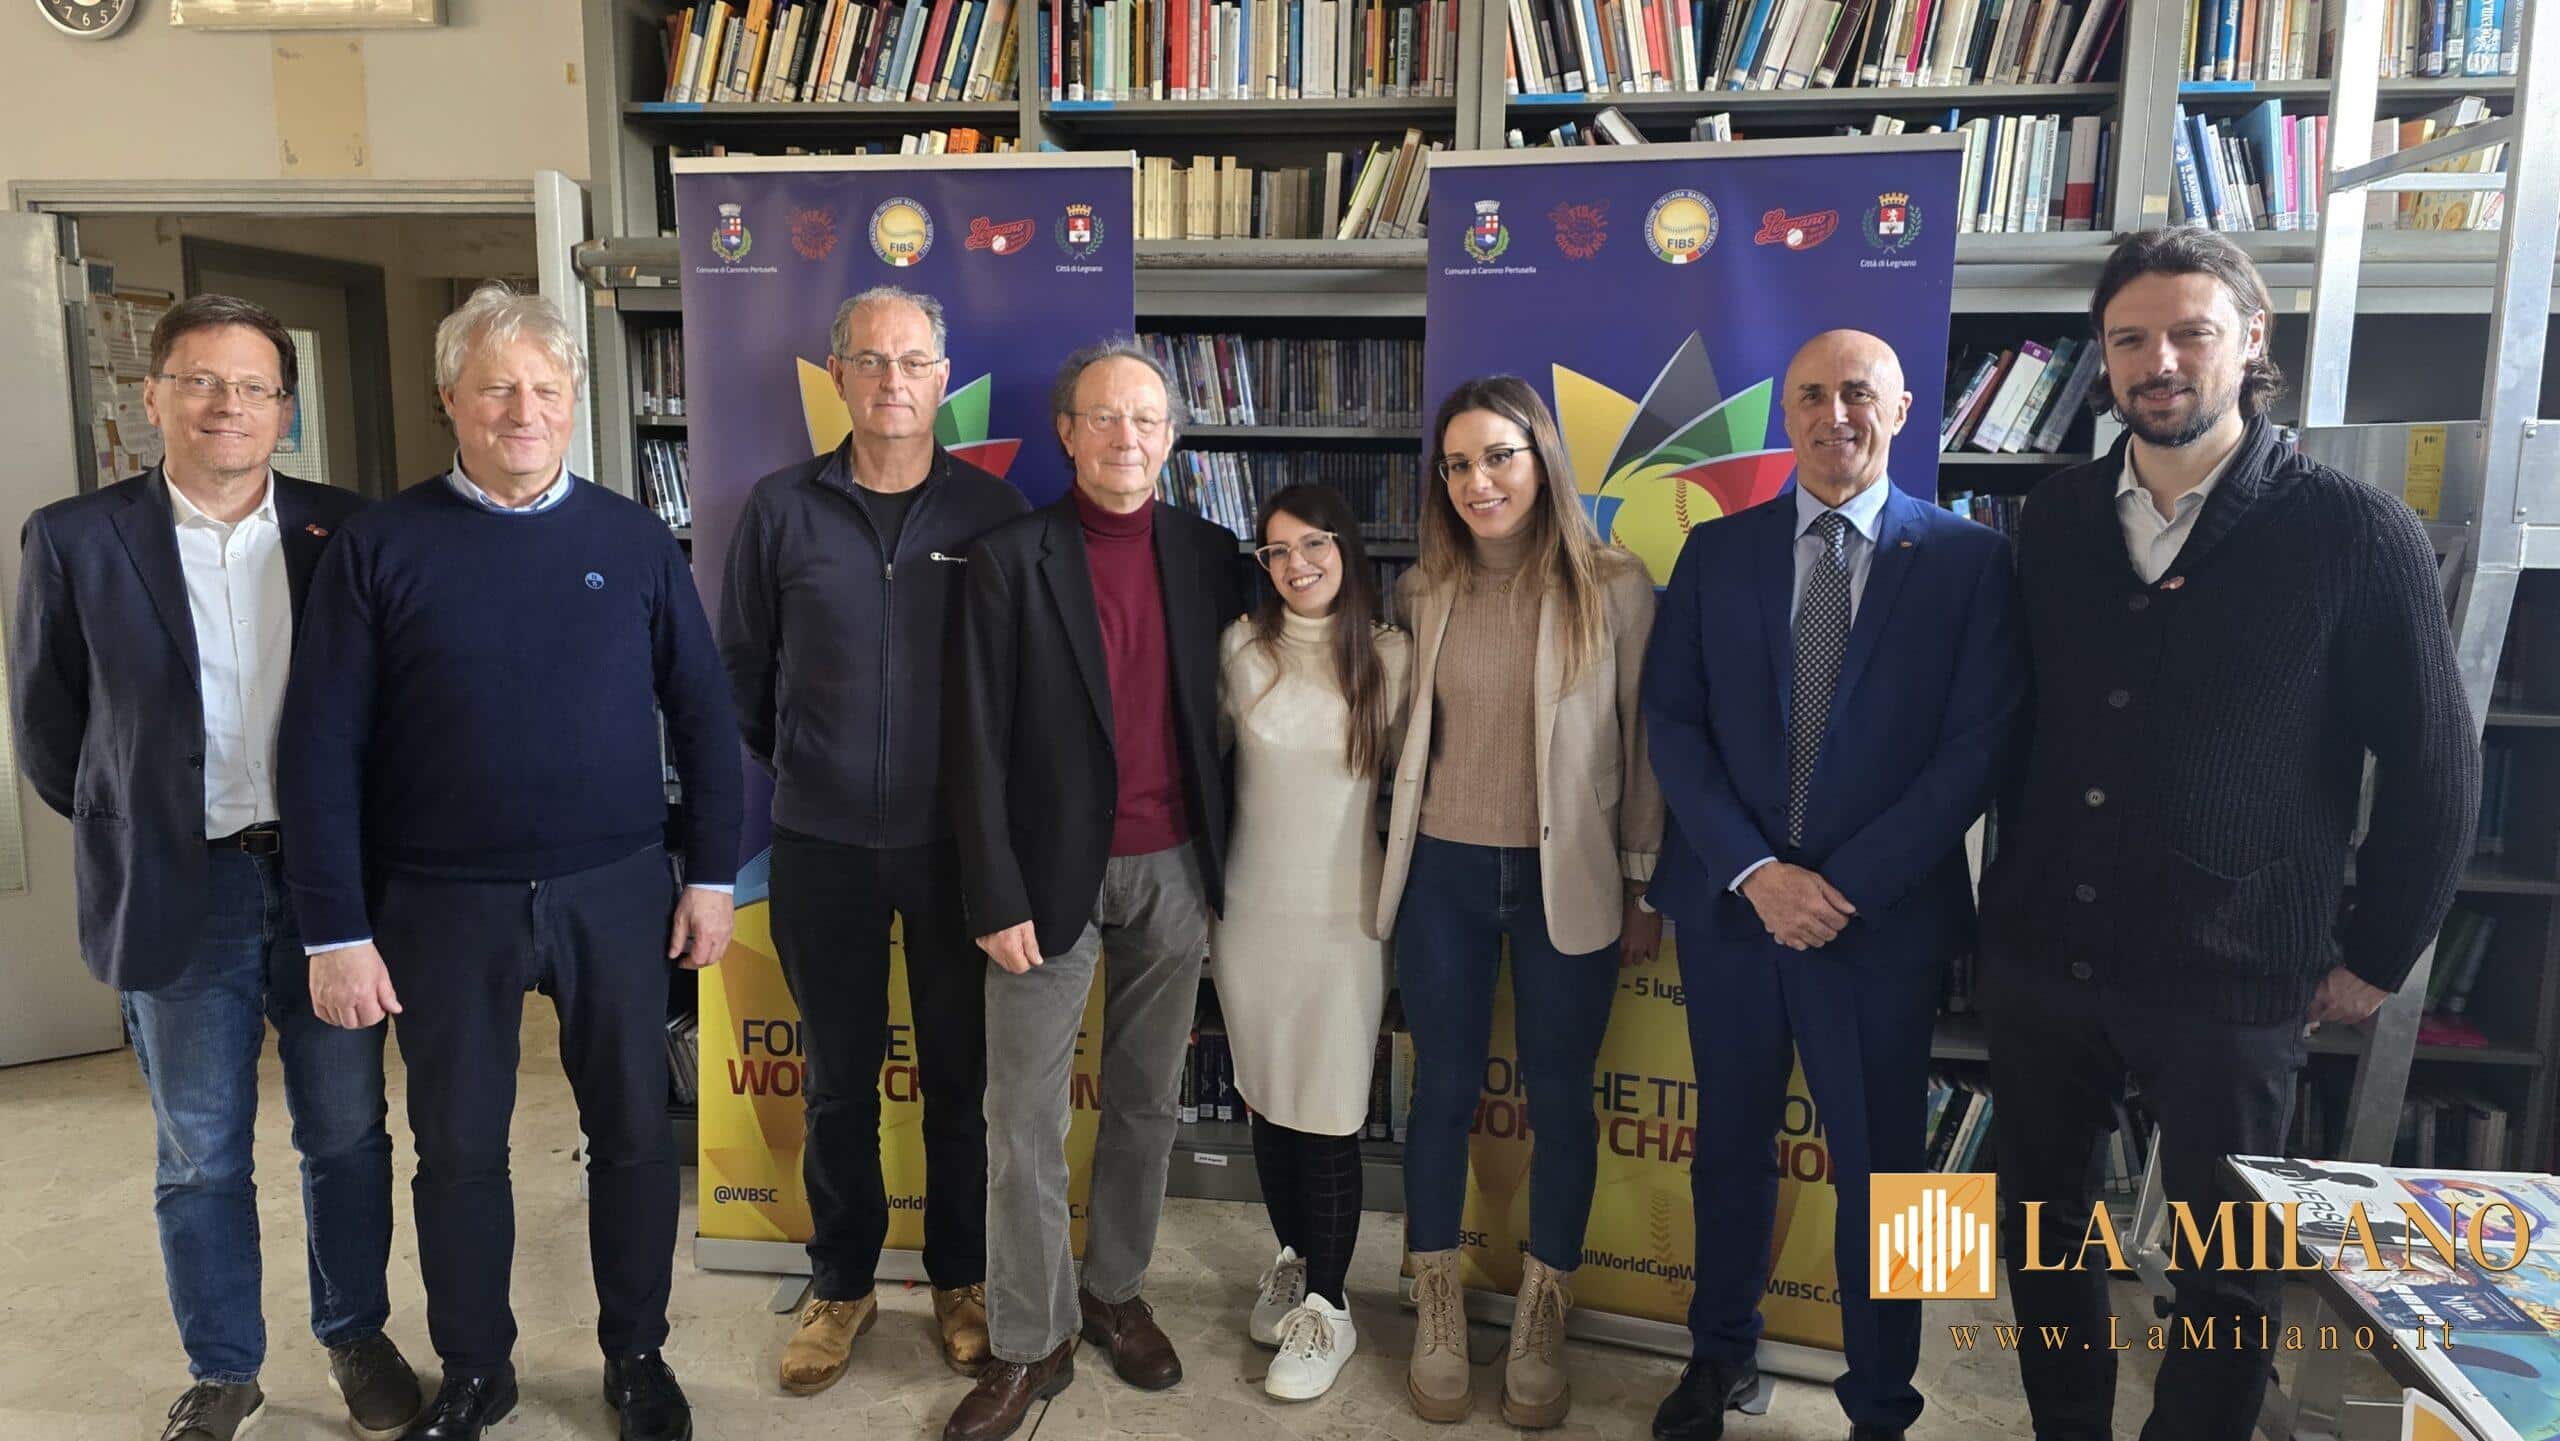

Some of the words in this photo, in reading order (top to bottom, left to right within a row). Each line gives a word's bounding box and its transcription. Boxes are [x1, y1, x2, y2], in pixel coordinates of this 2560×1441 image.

[64, 6, 73, 20] 7
[82, 12, 91, 26] 6
[100, 9, 108, 24] 5
[890, 242, 914, 253] FIBS
[1667, 237, 1695, 249] FIBS
[1860, 259, 1877, 268] Città
[1877, 259, 1886, 268] di
[1886, 259, 1917, 269] Legnano
[1635, 976, 1649, 996] 5
[1593, 1071, 1640, 1113] HE
[714, 1185, 779, 1205] @WBSC
